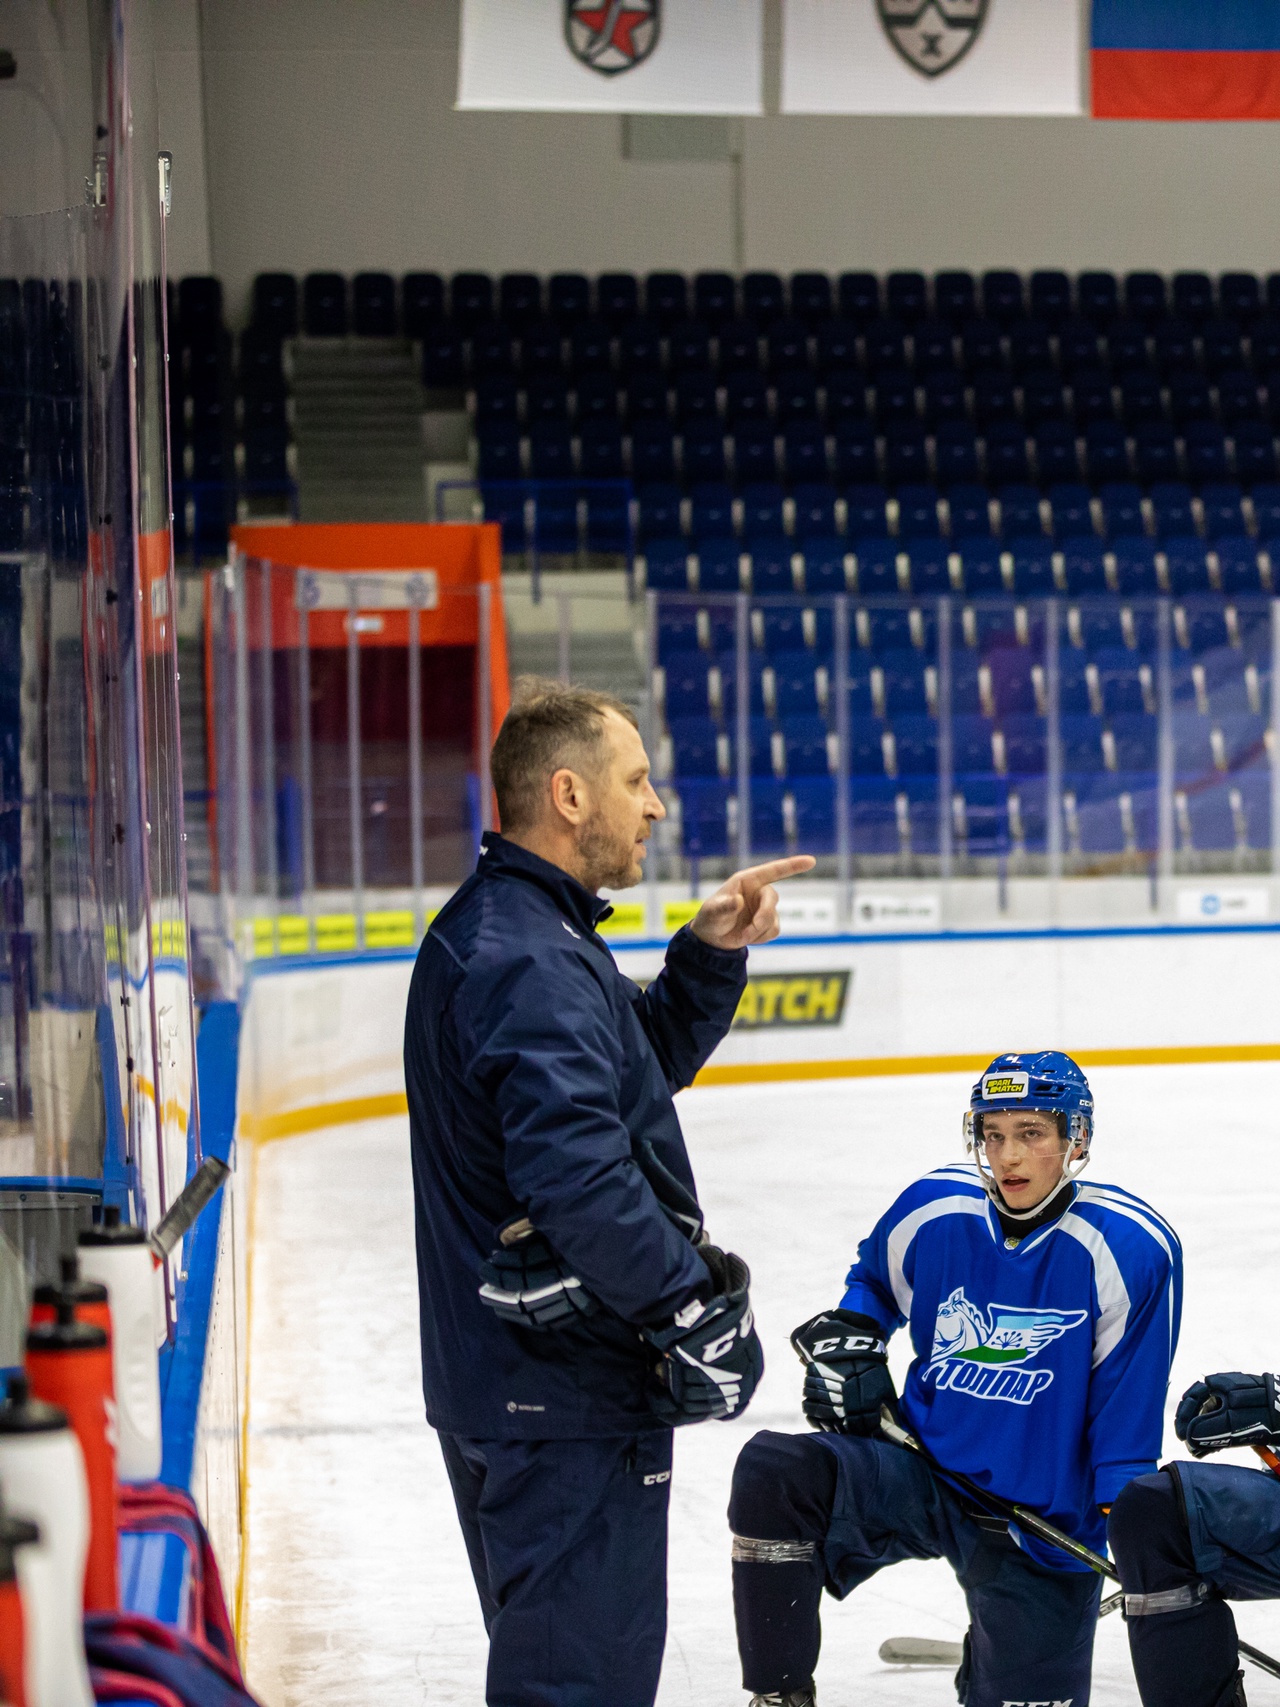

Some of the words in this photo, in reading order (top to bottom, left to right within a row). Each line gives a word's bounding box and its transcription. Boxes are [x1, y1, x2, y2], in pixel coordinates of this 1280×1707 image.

[733, 978, 842, 1024] ATCH
[988, 1078, 1012, 1087] PARI
[990, 1085, 1023, 1094] MATCH
[936, 1358, 1052, 1403] ТОЛПАР
